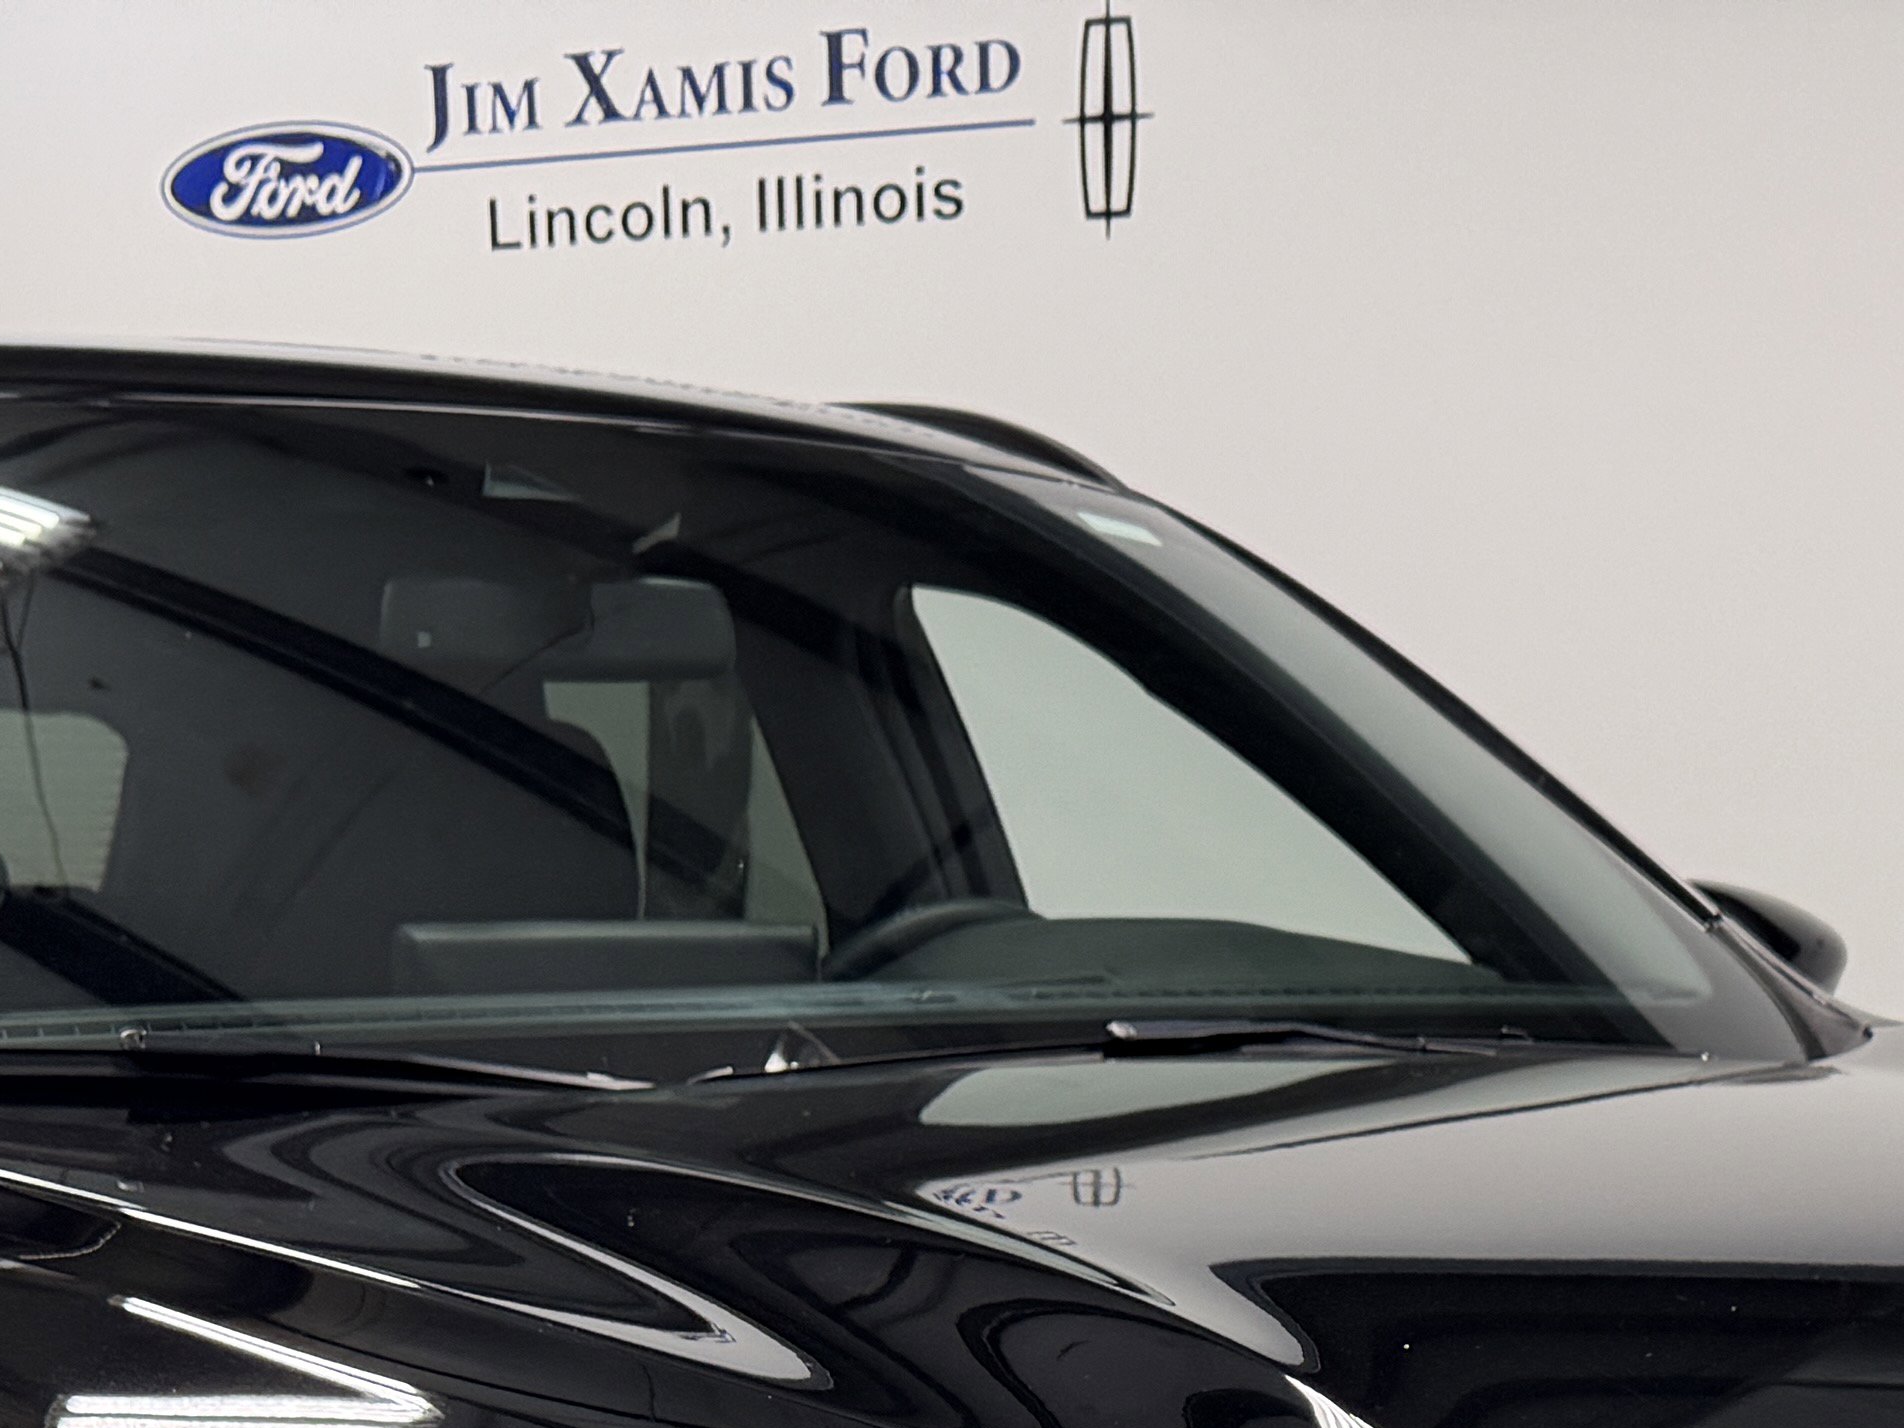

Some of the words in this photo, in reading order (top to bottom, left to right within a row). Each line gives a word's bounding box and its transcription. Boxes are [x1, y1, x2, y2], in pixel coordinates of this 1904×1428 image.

[424, 62, 542, 153] JIM
[564, 48, 795, 127] XAMIS
[820, 28, 1021, 106] FORD
[210, 141, 363, 221] Ford
[489, 185, 732, 248] Lincoln,
[757, 166, 965, 231] Illinois
